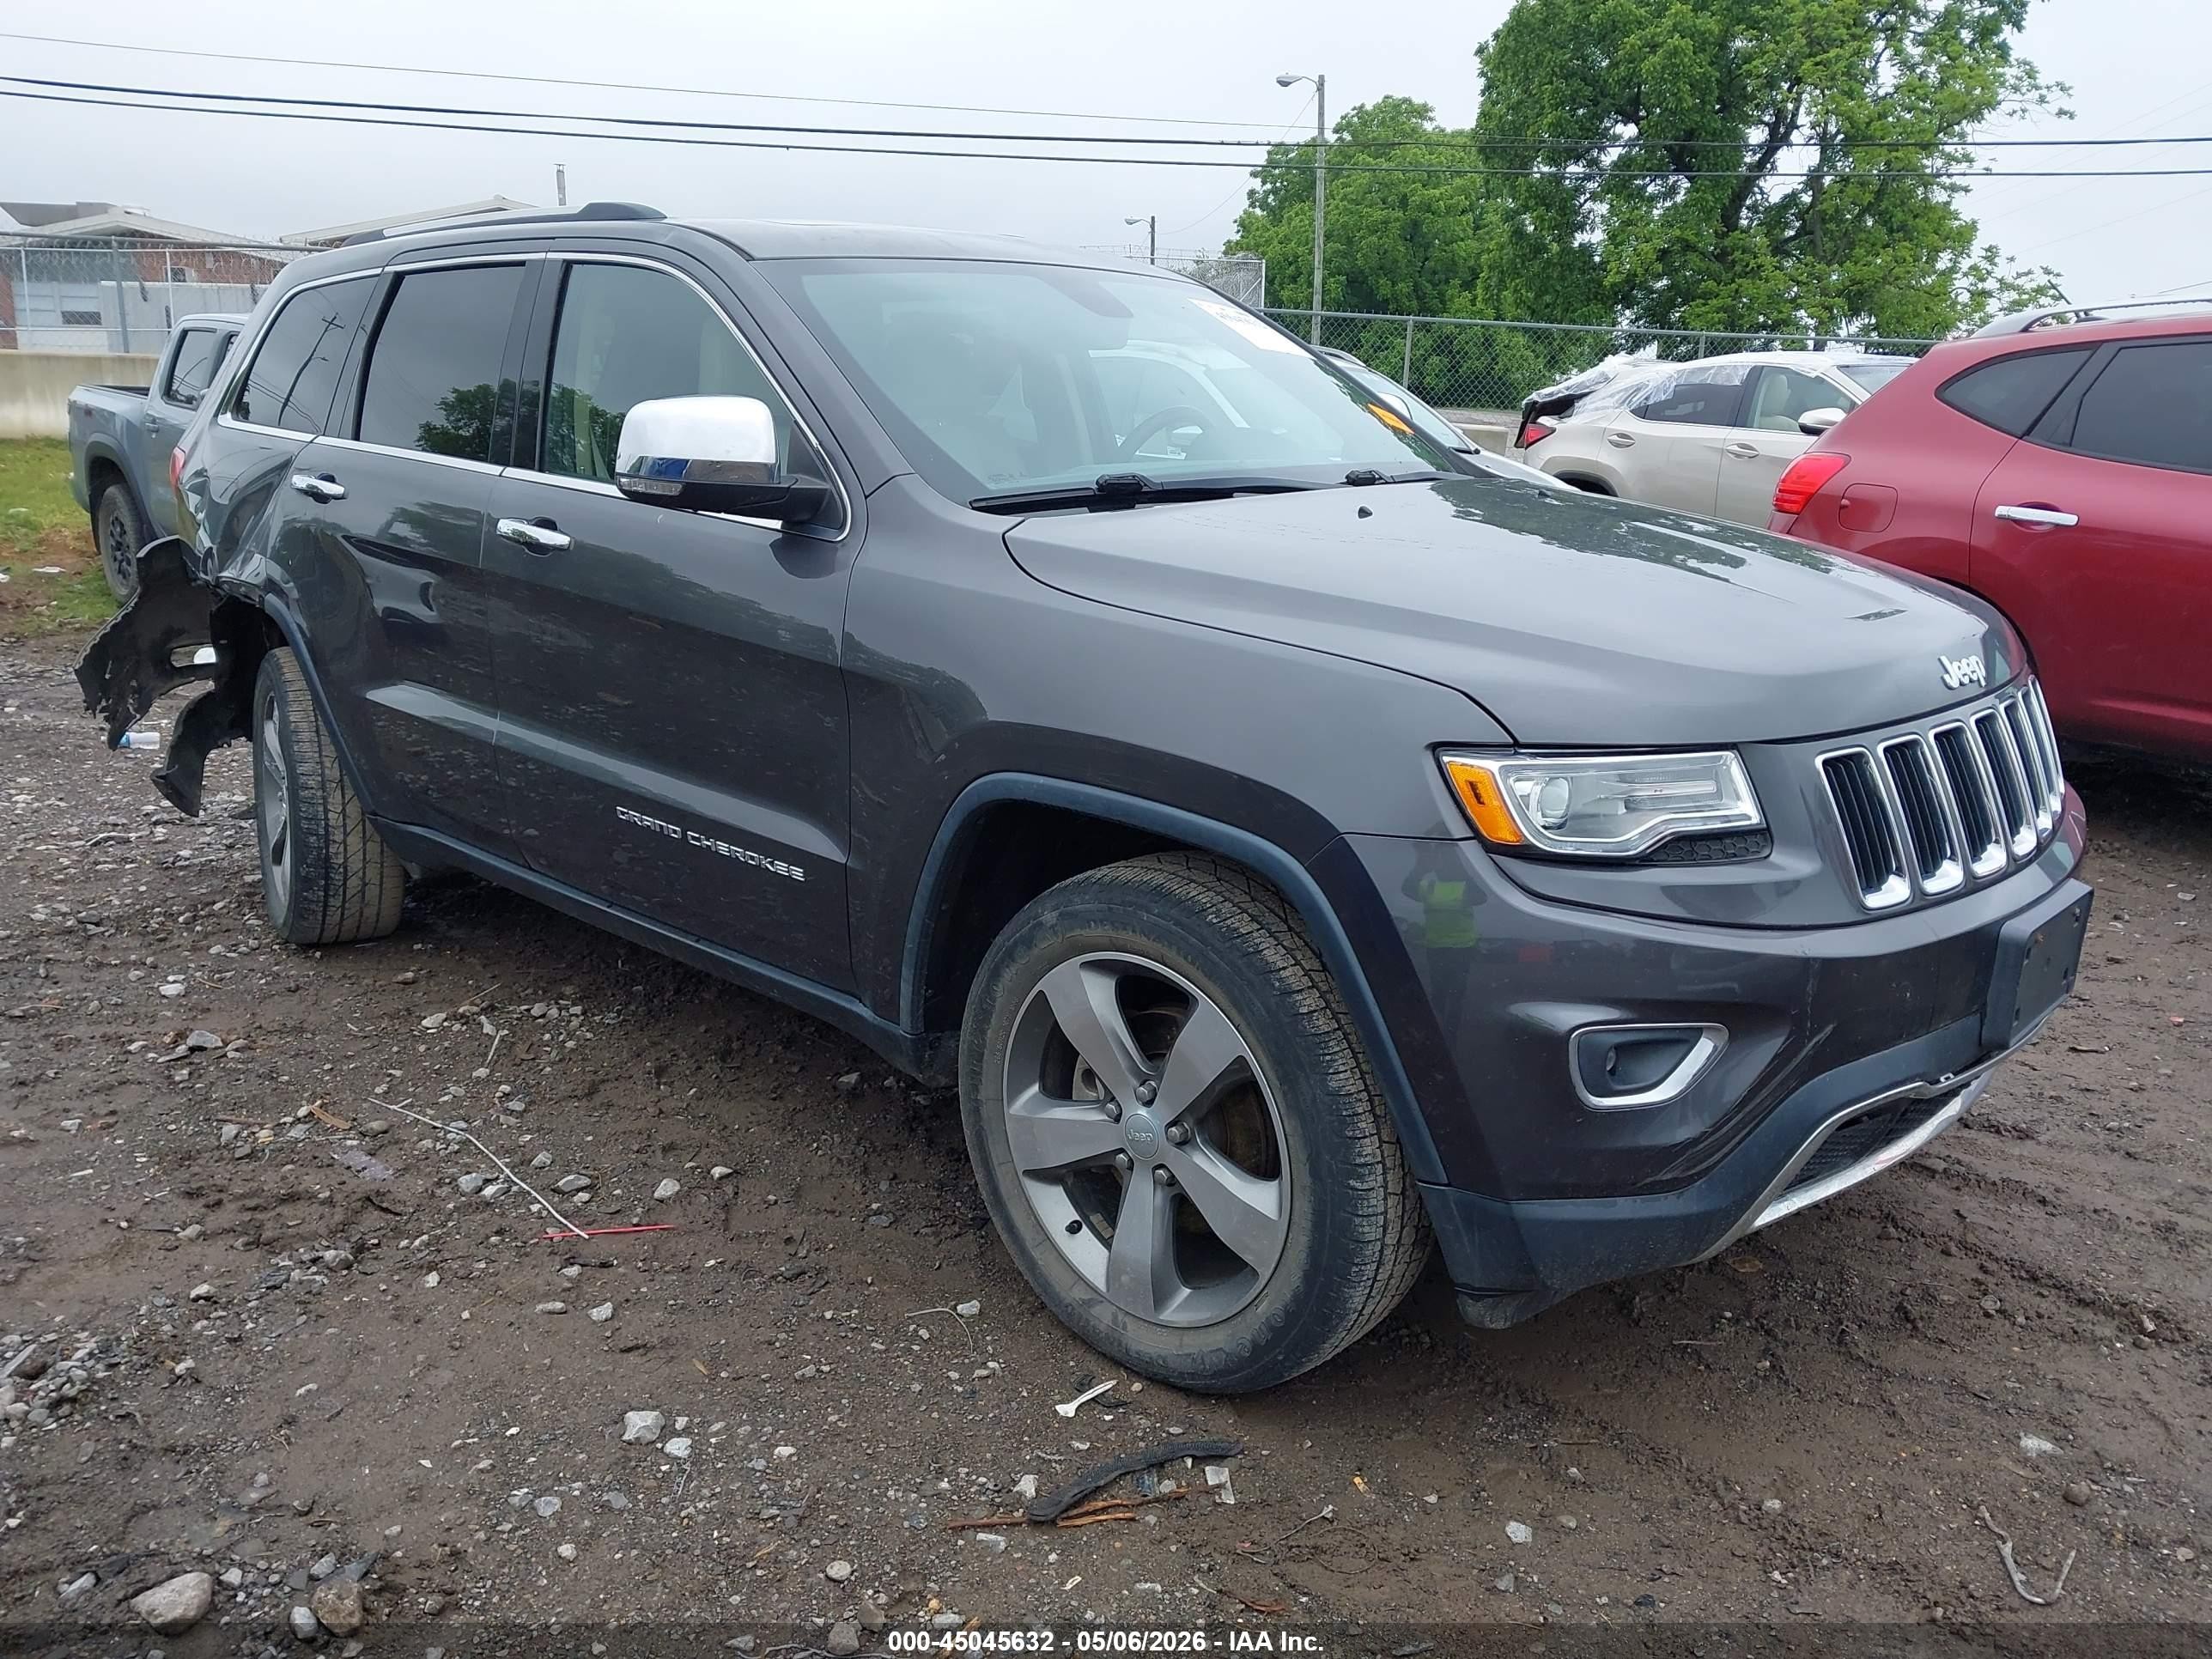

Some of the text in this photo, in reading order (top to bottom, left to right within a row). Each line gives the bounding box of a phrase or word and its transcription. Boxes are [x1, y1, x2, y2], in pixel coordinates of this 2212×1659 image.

[1938, 654, 1987, 690] Jeep
[615, 805, 806, 882] GRAND CHEROKEE
[1127, 1128, 1154, 1145] Jeep
